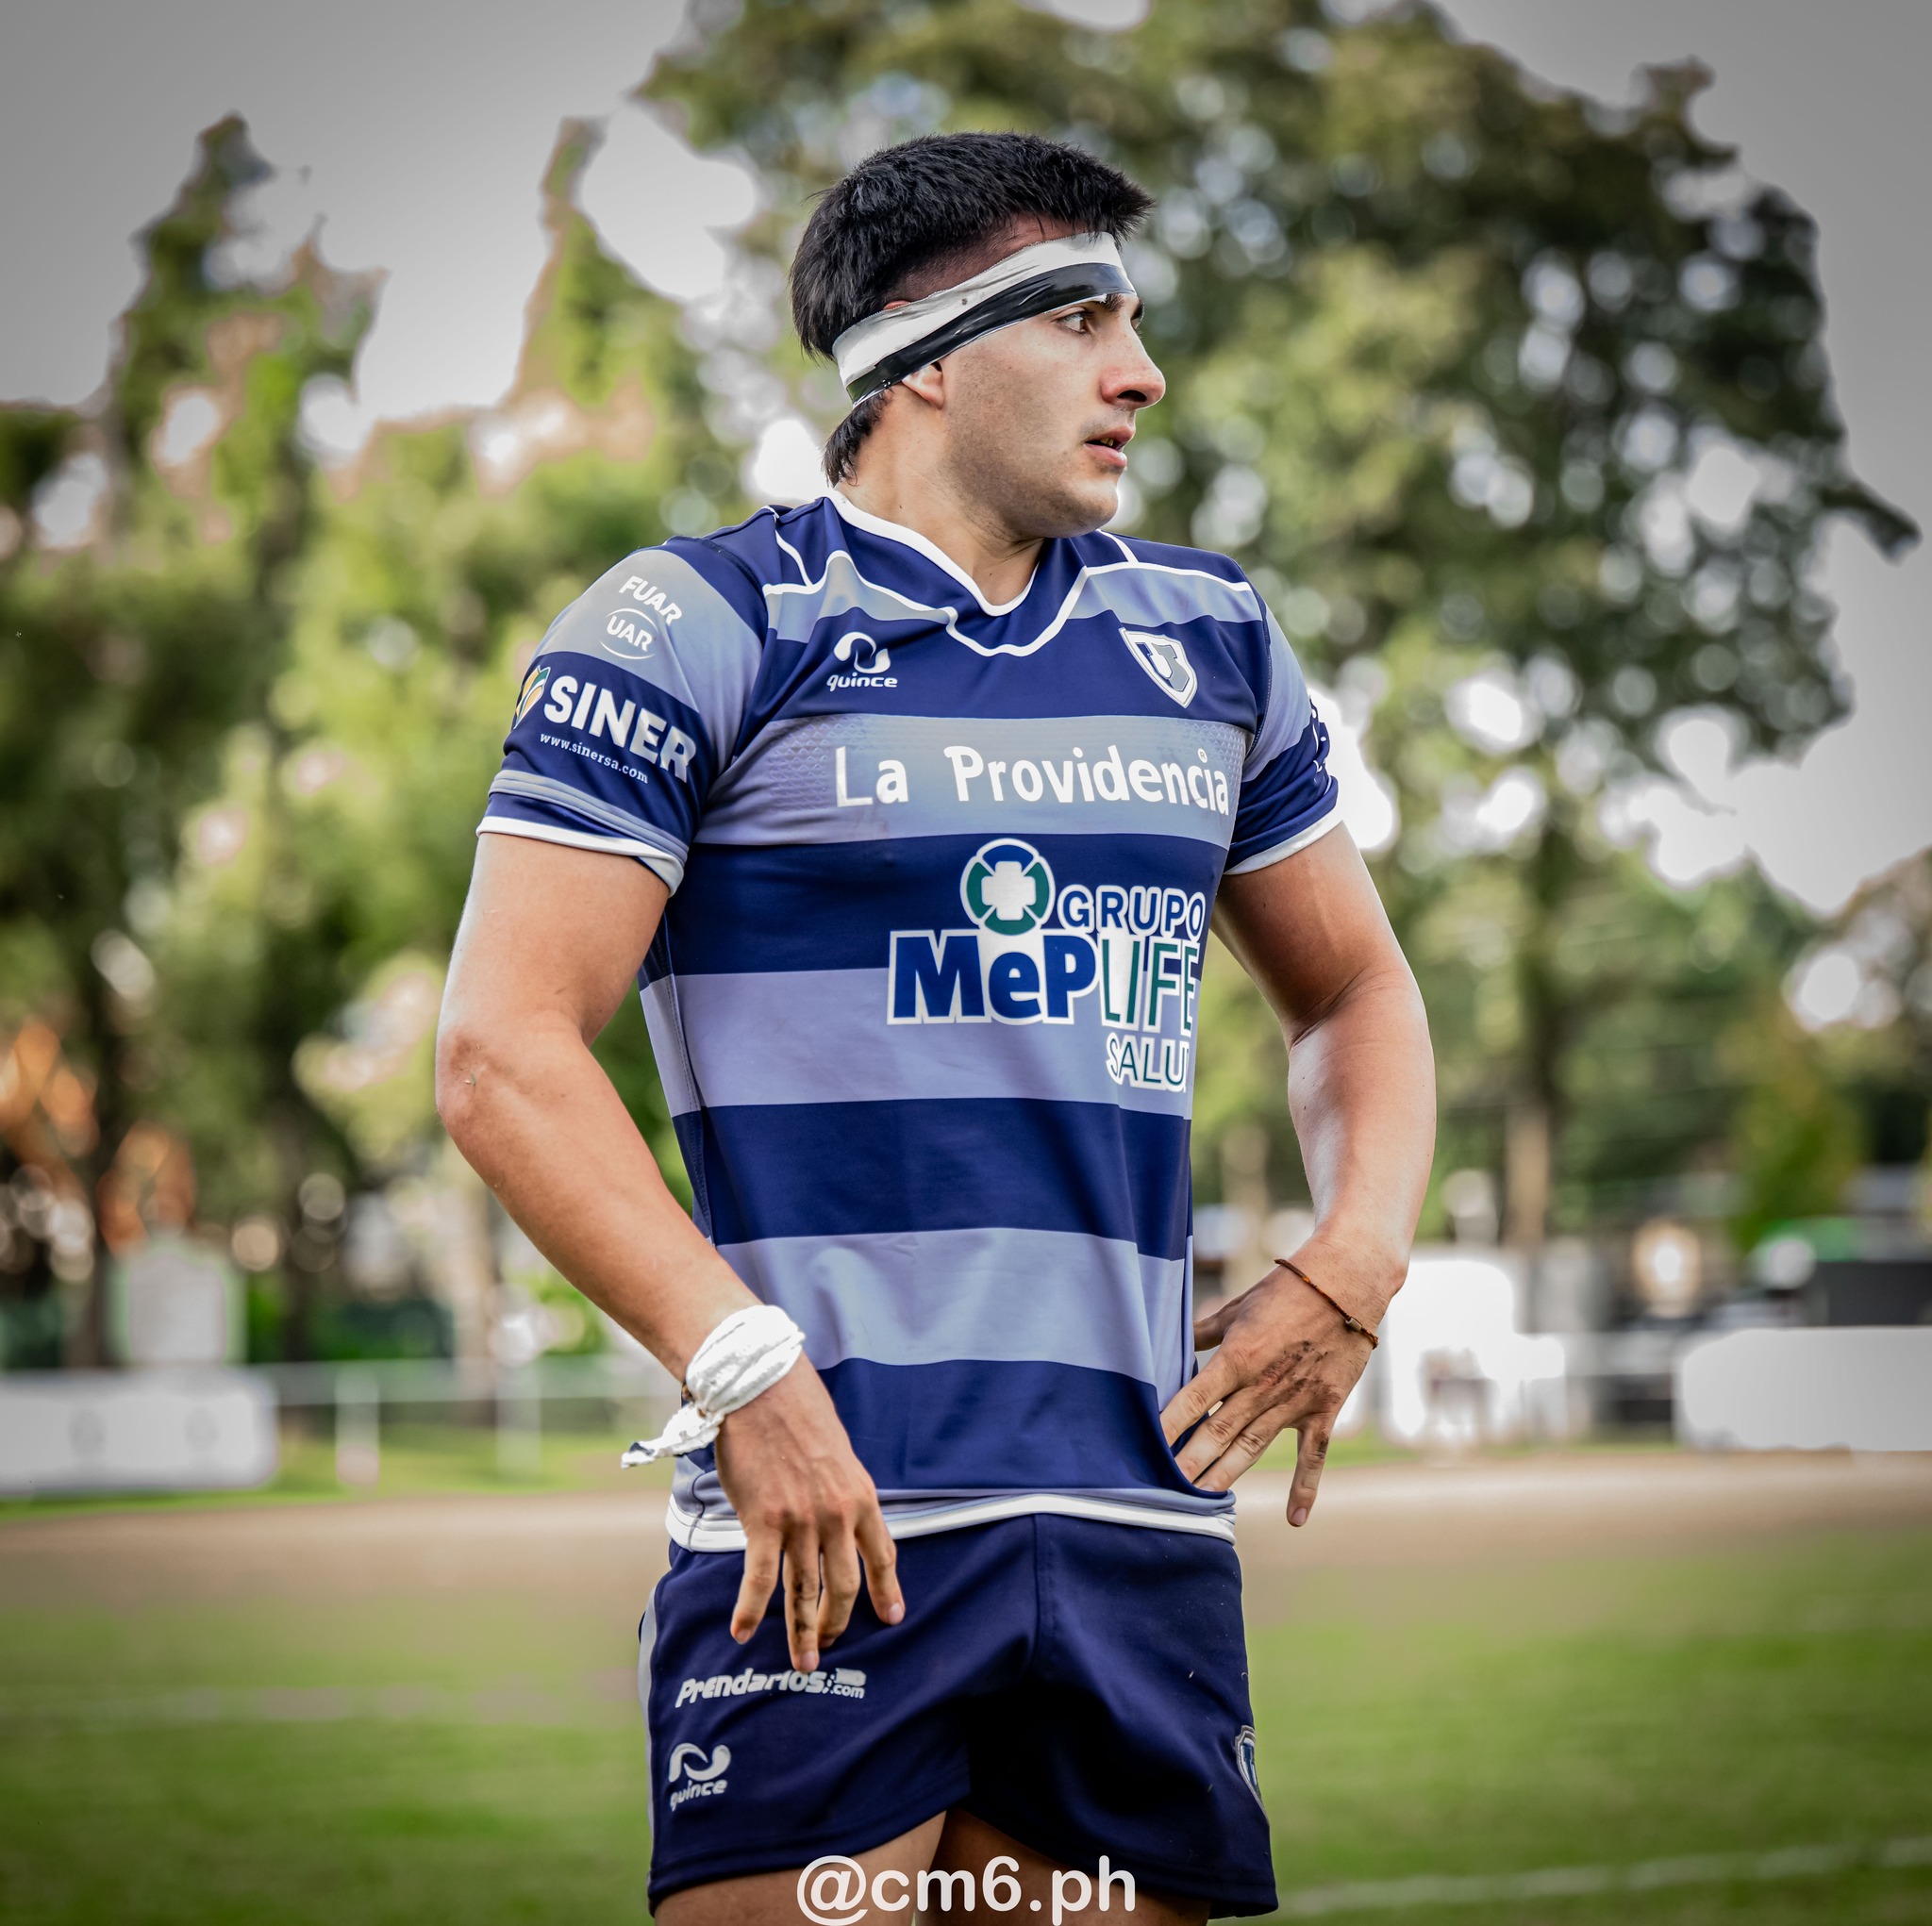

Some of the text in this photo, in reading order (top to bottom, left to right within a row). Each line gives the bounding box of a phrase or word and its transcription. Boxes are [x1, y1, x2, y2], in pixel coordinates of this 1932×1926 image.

[619, 575, 682, 626] FUAR
[606, 615, 654, 652] UAR
[826, 672, 898, 692] quince
[543, 675, 696, 783] SINER
[540, 733, 649, 784] www.sinersa.com
[836, 746, 909, 808] La
[944, 744, 1229, 816] Providencia
[1060, 888, 1205, 938] GRUPO
[1108, 1035, 1189, 1089] SALU
[670, 1779, 727, 1812] quince
